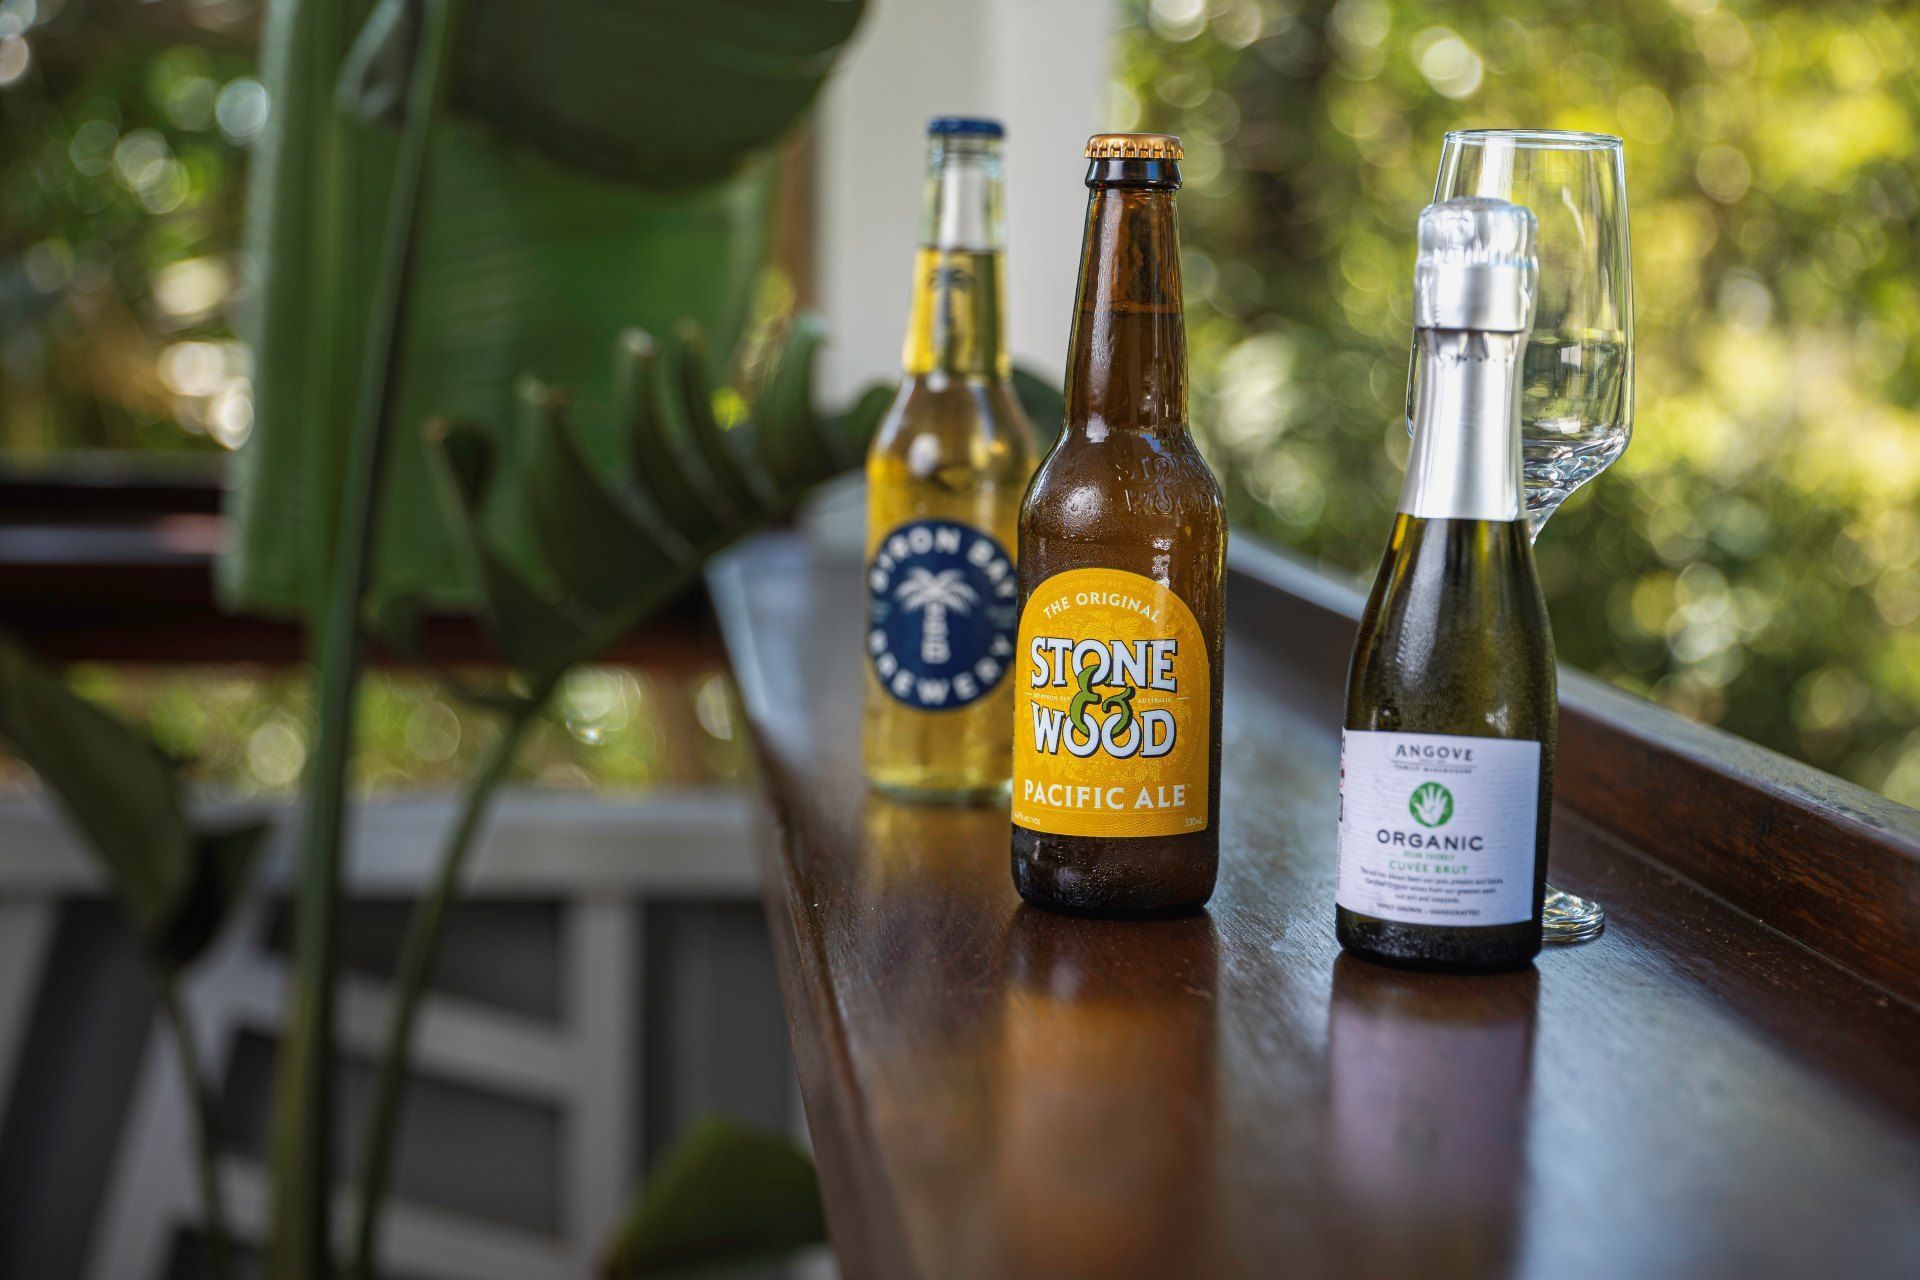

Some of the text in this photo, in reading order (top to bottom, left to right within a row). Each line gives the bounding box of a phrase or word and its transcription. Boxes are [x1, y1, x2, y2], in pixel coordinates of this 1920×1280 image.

[1043, 596, 1071, 620] THE
[1076, 591, 1160, 623] ORIGINAL
[1030, 636, 1178, 693] STONE
[1030, 700, 1177, 760] WOOD
[1395, 744, 1473, 761] ANGOVE
[1024, 778, 1187, 810] PACIFIC ALE
[1377, 829, 1484, 852] ORGANIC
[1435, 864, 1468, 875] BRUT
